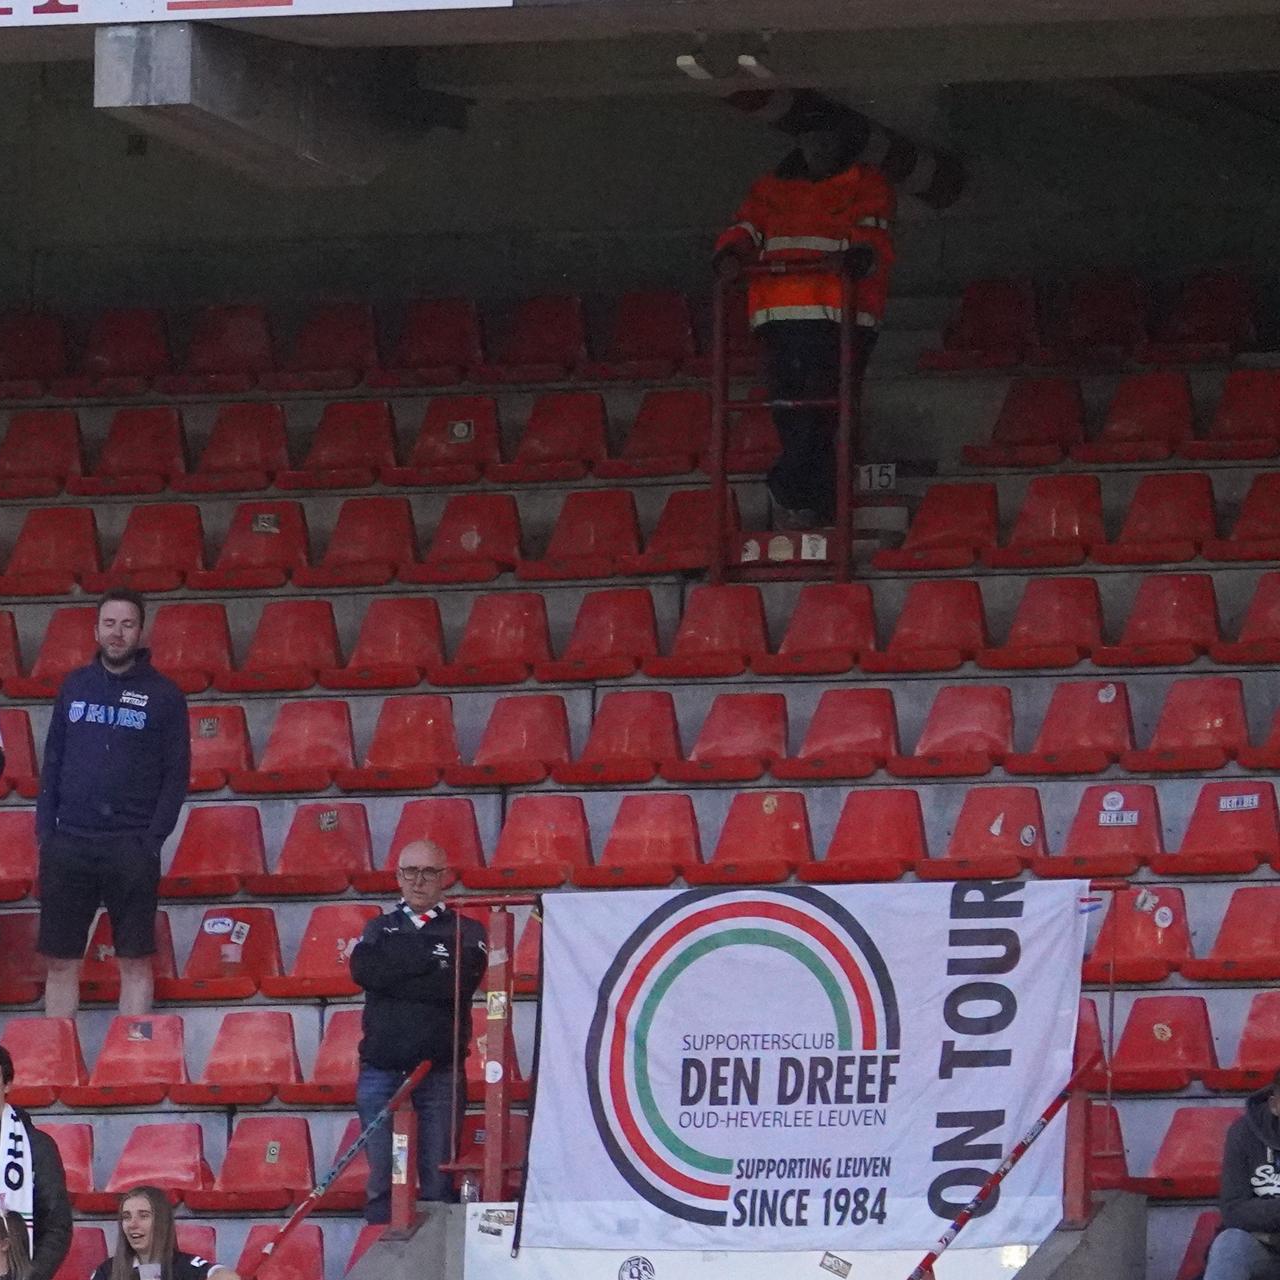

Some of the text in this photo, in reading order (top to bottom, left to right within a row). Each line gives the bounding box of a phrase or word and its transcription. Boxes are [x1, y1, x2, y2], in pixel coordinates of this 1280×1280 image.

[865, 465, 892, 487] 15
[938, 881, 1027, 1080] TOUR
[682, 1033, 835, 1051] SUPPORTERSCLUB
[680, 1055, 901, 1106] DEN DREEF
[679, 1109, 887, 1129] OUD-HEVERLEE LEUVEN
[735, 1157, 892, 1179] SUPPORTING LEUVEN
[927, 1109, 1007, 1221] ON
[732, 1187, 888, 1227] SINCE 1984
